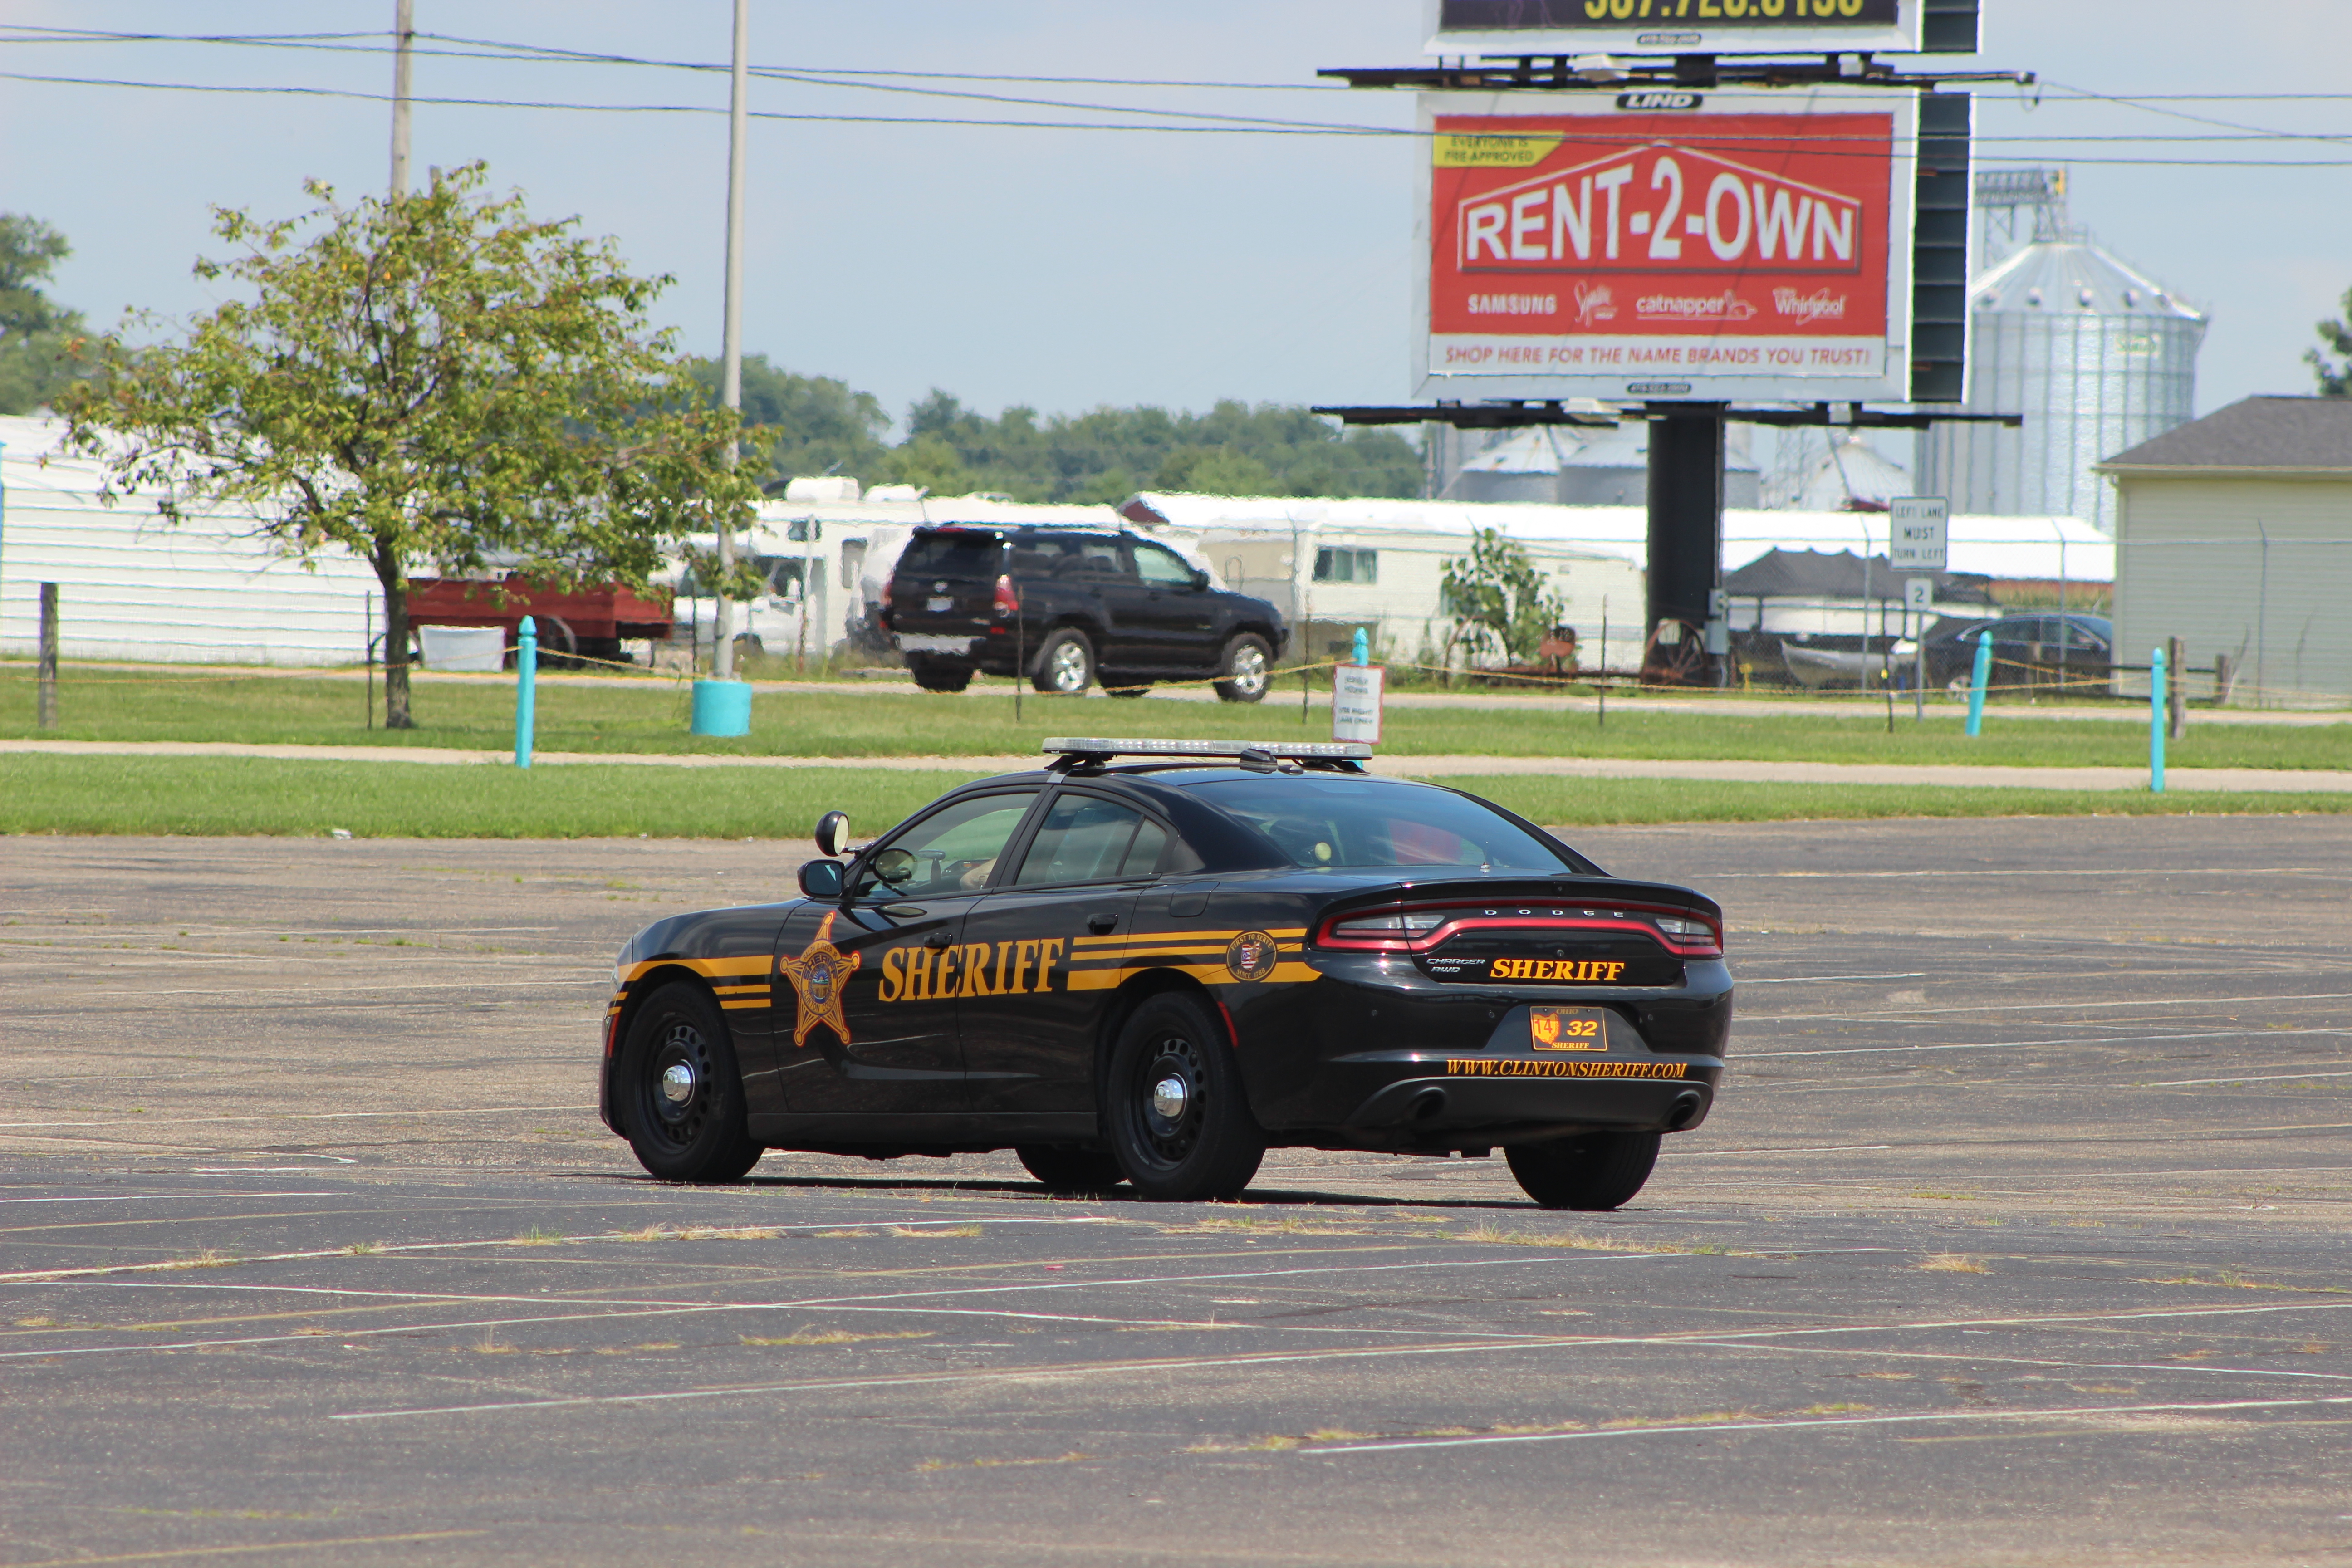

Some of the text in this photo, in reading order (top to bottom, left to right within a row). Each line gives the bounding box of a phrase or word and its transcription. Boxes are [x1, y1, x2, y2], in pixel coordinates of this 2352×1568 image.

[1626, 93, 1694, 109] LIND
[1451, 136, 1528, 148] EVERYONE IS
[1466, 155, 1852, 261] RENT-2-OWN
[1468, 293, 1558, 315] SAMSUNG
[1636, 293, 1725, 316] catnapper
[1773, 288, 1847, 319] Whirlpool
[1446, 346, 1871, 364] SHOP HERE FOR THE NAME BRANDS YOU TRUST!
[1896, 506, 1944, 519] LEFT LANE
[1904, 527, 1934, 539] MUST
[1894, 548, 1944, 559] TURN LEFT
[1914, 586, 1923, 603] 2
[1485, 909, 1624, 918] DODGE
[1231, 936, 1247, 951] FIRST
[1256, 934, 1273, 949] SERVE
[803, 945, 815, 960] RALPH
[804, 955, 837, 980] SHERIFF
[878, 937, 1064, 1002] SHERIFF
[1236, 967, 1266, 979] SINCE 1788
[1490, 959, 1624, 980] SHERIFF
[803, 989, 836, 1012] CLINTON COUNTY
[1534, 1019, 1598, 1036] 14 32
[1446, 1059, 1687, 1078] WWW.CLINTONSHERIFF.COM
